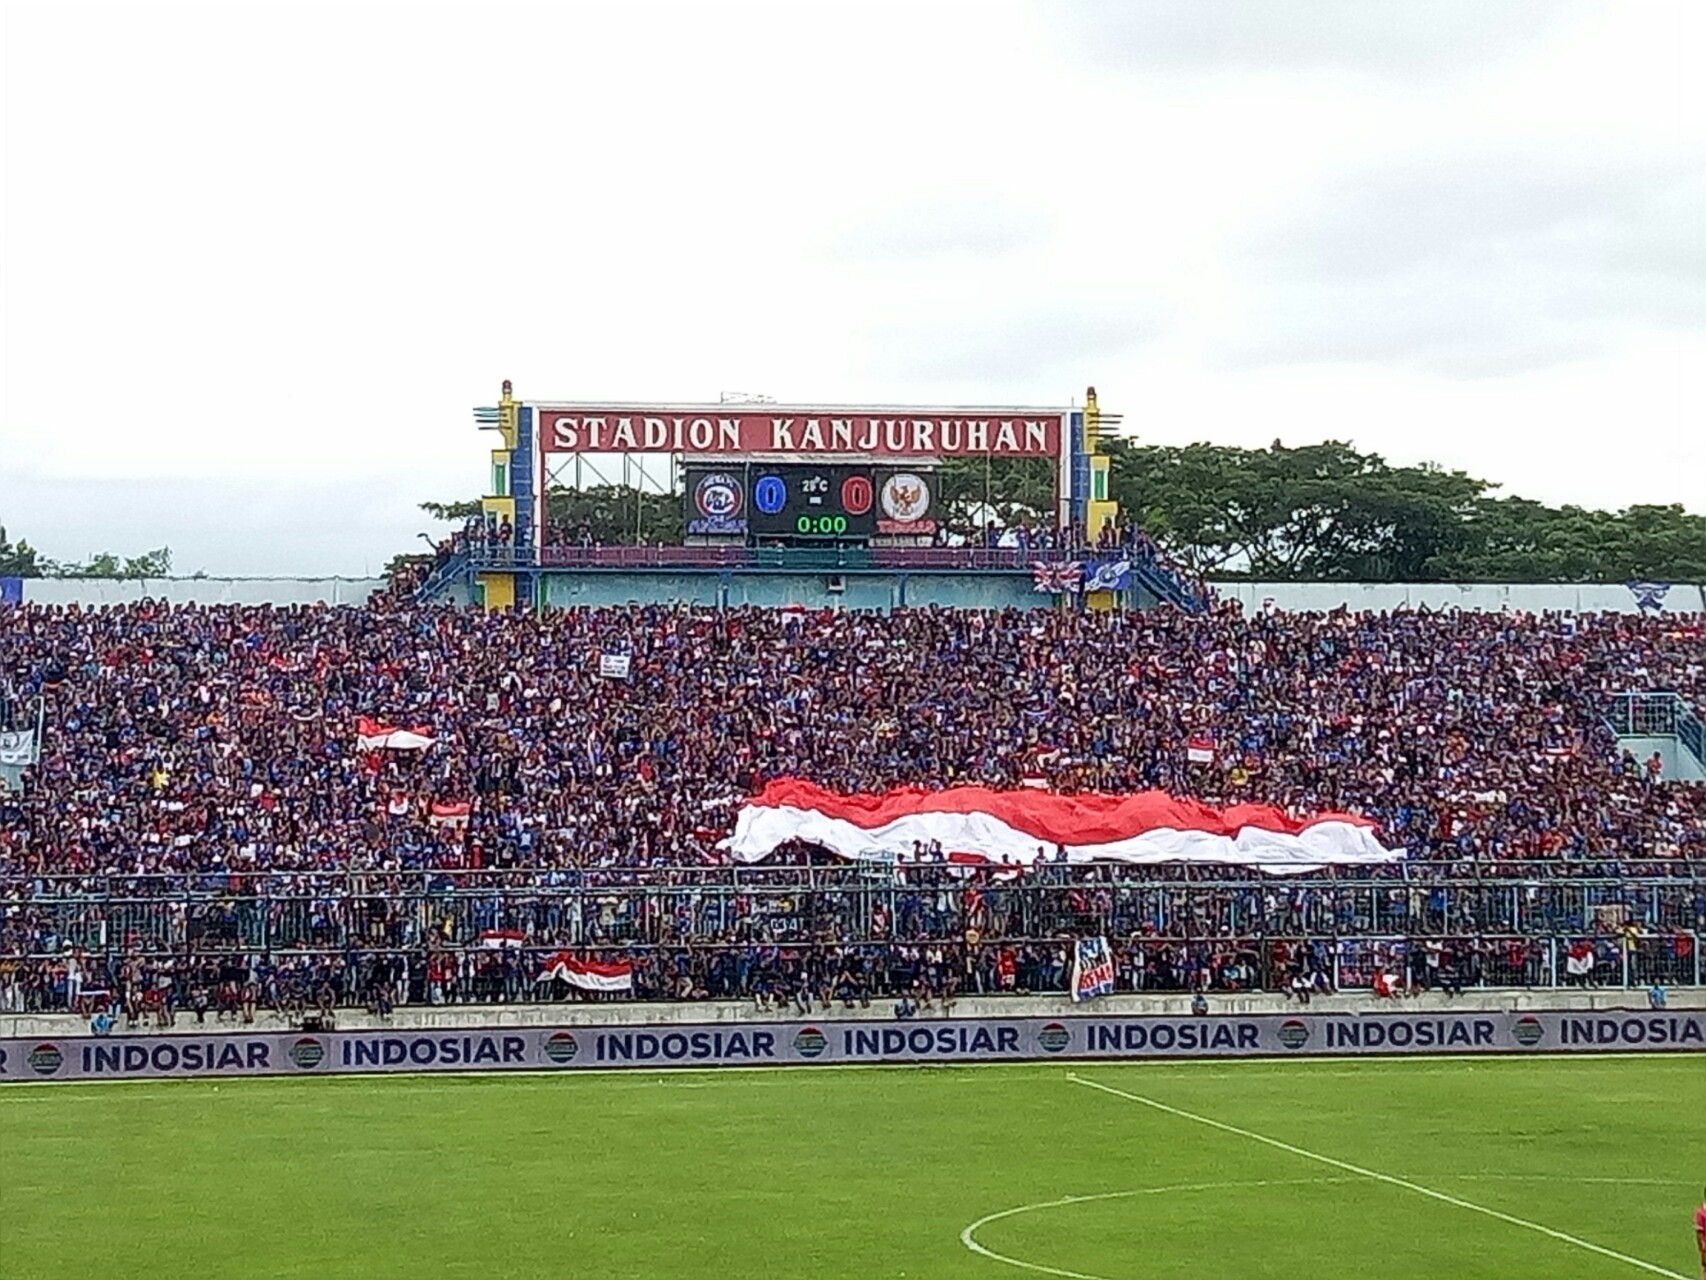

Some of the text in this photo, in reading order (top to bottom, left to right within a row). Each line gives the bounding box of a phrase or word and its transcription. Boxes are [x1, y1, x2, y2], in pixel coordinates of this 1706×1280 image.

[553, 416, 1048, 452] STADION KANJURUHAN
[756, 476, 786, 514] 0
[841, 476, 873, 515] 0
[798, 516, 847, 533] 0:00
[596, 1031, 776, 1061] INDOSIAR
[843, 1026, 1021, 1056] INDOSIAR
[1087, 1022, 1261, 1051] INDOSIAR
[1326, 1018, 1496, 1048] INDOSIAR
[82, 1042, 271, 1073] INDOSIAR
[342, 1036, 526, 1066] INDOSIAR
